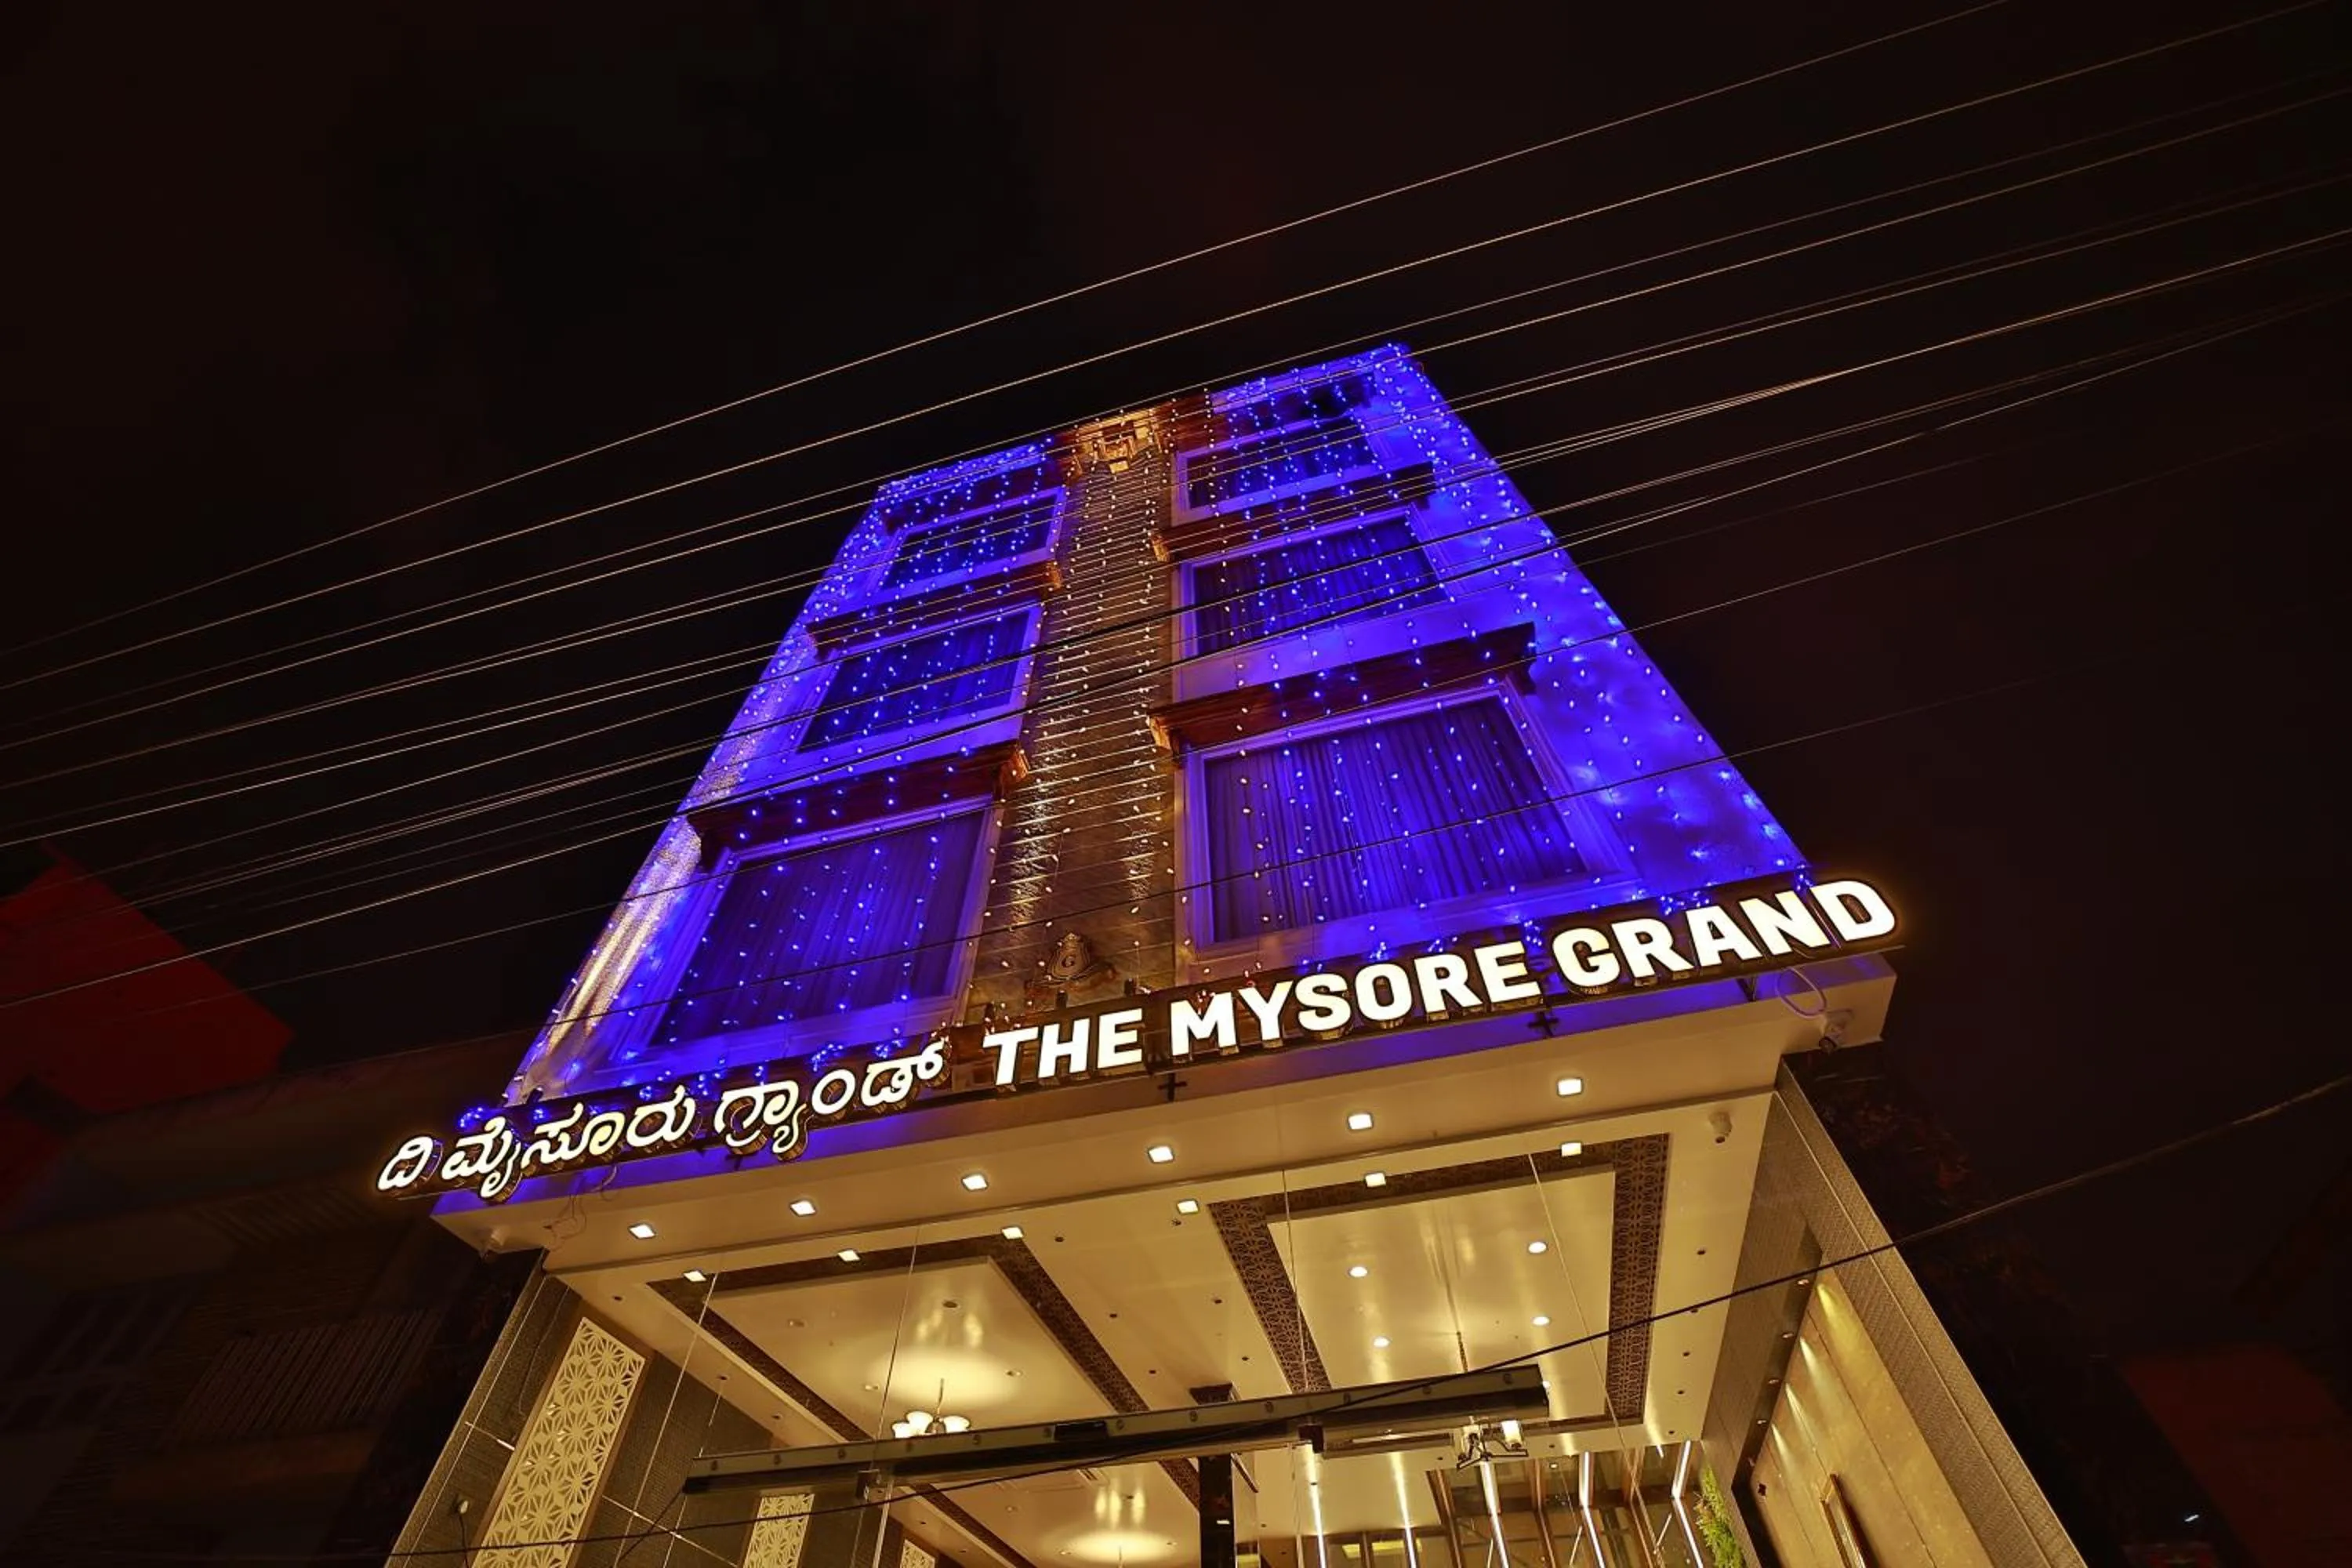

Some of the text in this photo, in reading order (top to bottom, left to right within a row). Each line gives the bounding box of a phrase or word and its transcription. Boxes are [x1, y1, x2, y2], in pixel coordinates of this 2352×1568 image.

[982, 880, 1896, 1086] THE MYSORE GRAND
[377, 1135, 434, 1191] ದಿ
[441, 1084, 696, 1198] ಮೈಸೂರು
